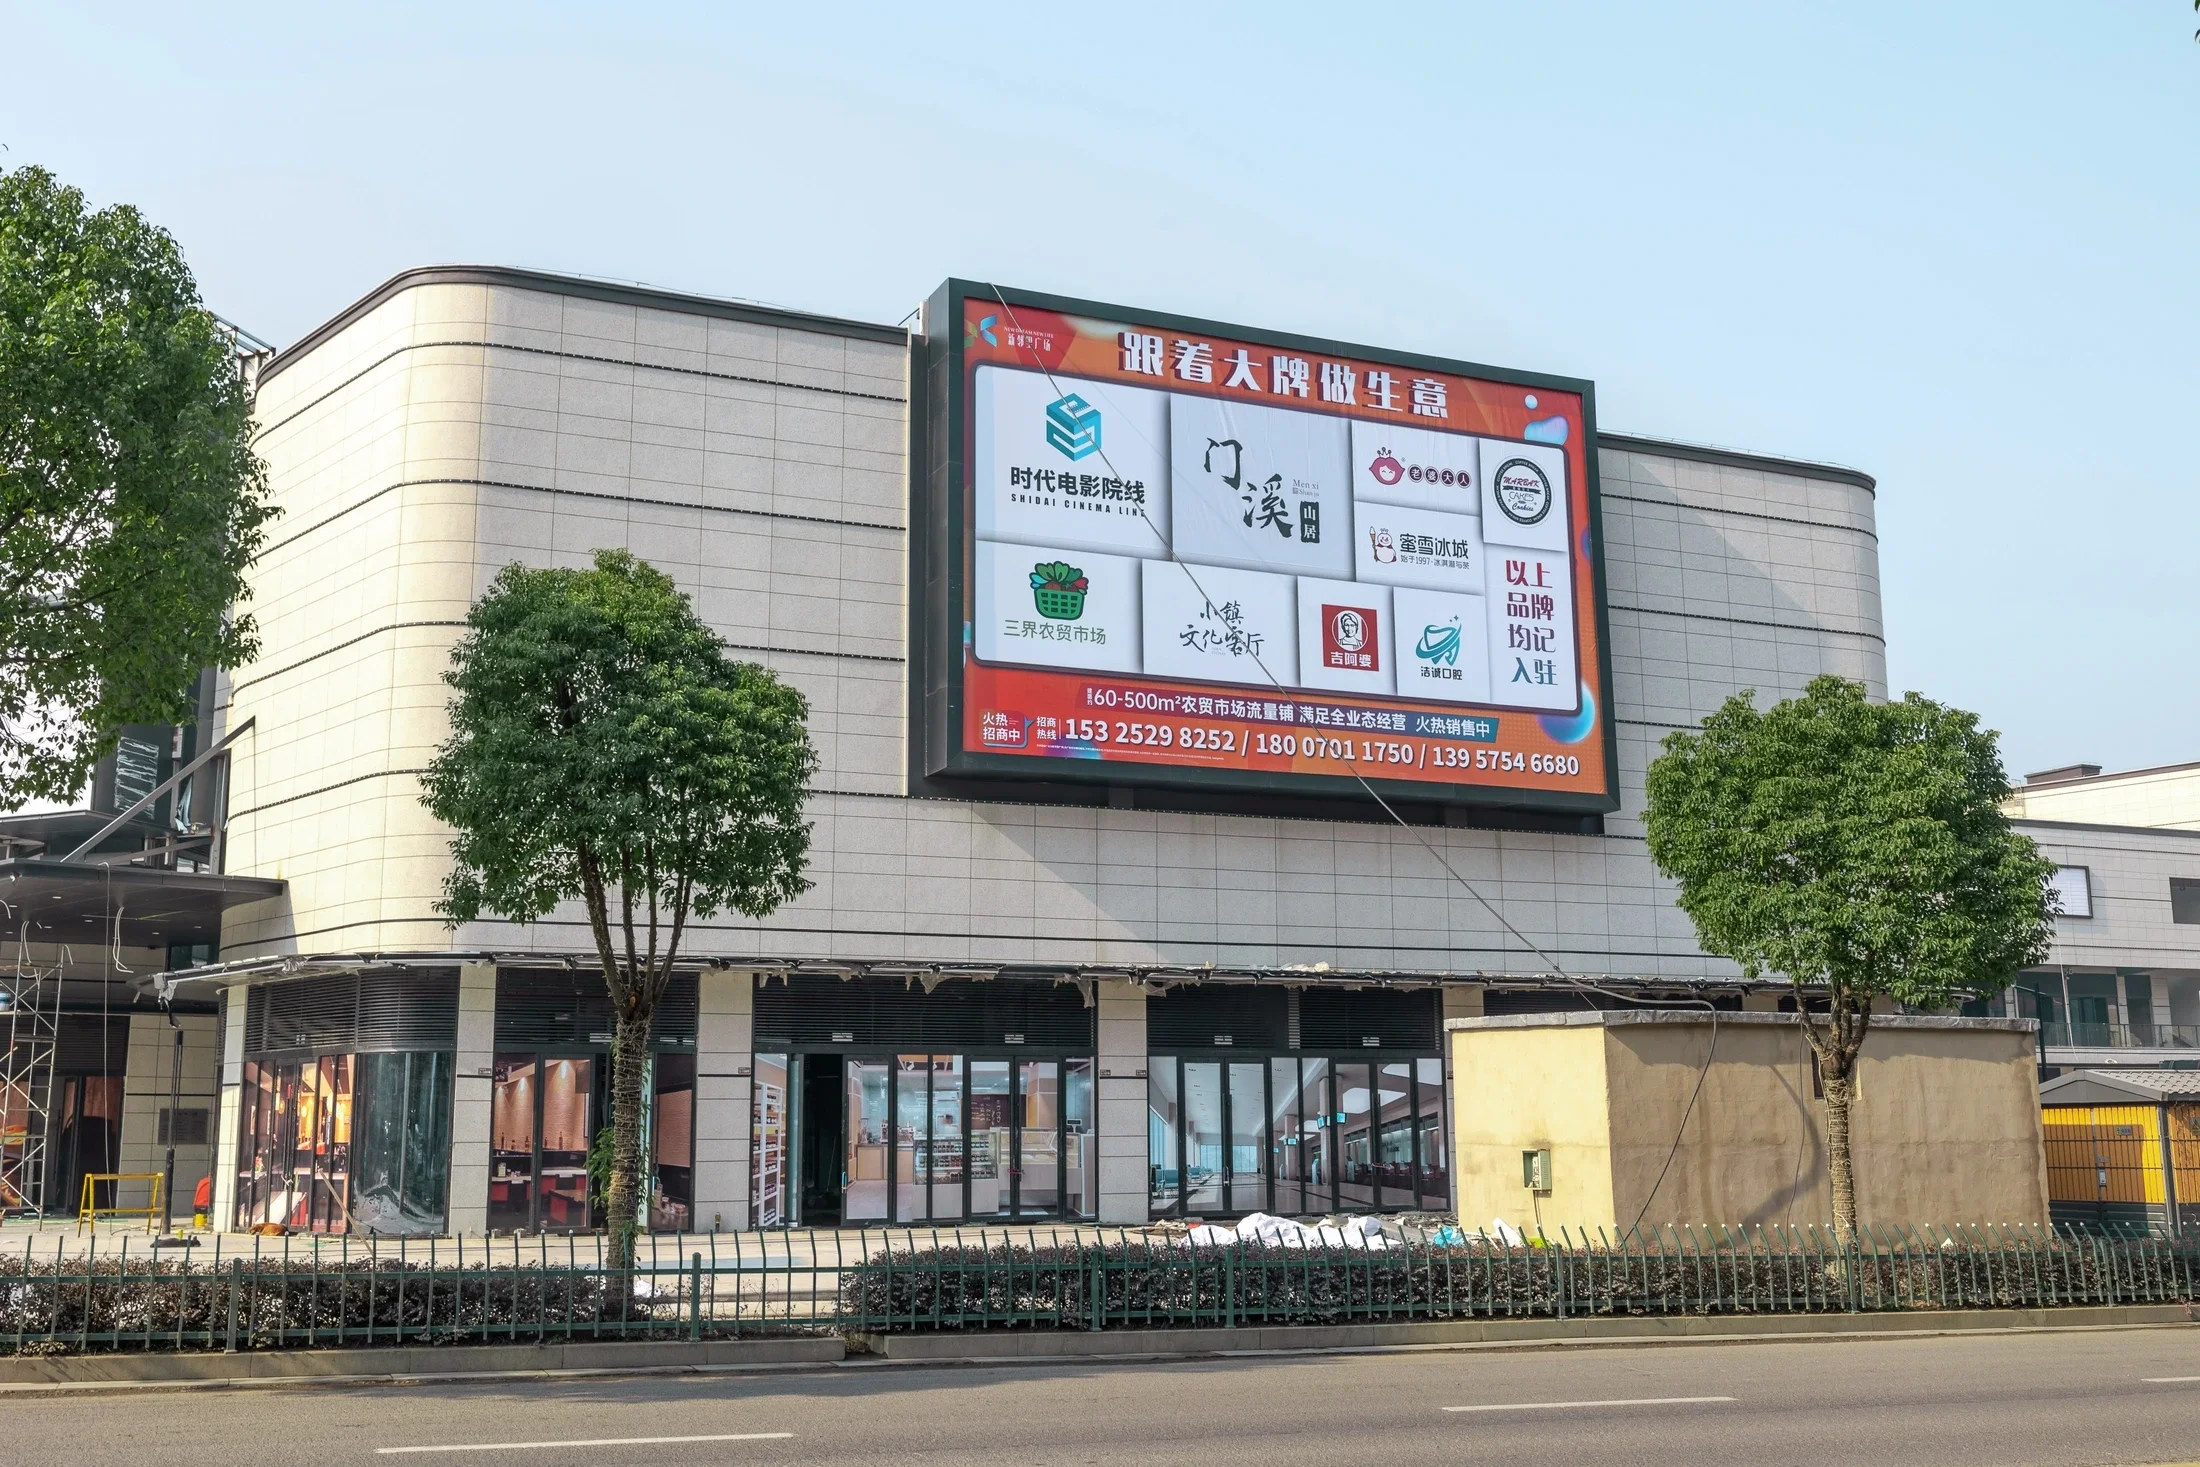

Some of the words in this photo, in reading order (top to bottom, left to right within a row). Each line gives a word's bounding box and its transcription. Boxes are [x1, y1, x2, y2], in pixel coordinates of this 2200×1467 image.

[1122, 331, 1449, 419] 跟着大牌做生意
[1010, 466, 1146, 505] 时代电影院线
[1293, 479, 1310, 489] Men
[1509, 492, 1534, 502] CAKES
[1011, 493, 1056, 507] SHIDAI
[1064, 499, 1111, 513] CINEMA
[1303, 505, 1317, 540] 山居
[1399, 532, 1469, 560] 蜜雪冰城
[1505, 559, 1553, 589] 以上
[1506, 591, 1555, 621] 品牌
[1003, 619, 1107, 646] 三界农贸市场
[1420, 665, 1462, 681] 洁诚口腔
[1510, 656, 1559, 686] 入驻
[982, 711, 1009, 727] 火热
[1036, 716, 1057, 728] 招商
[1299, 705, 1407, 731] 满足全业态经营
[1415, 716, 1491, 739] 火热销售中
[982, 726, 1021, 742] 招商中
[1036, 728, 1057, 741] 热线
[1065, 718, 1109, 743] 153
[1115, 722, 1173, 747] 2529
[1179, 727, 1236, 752] 8252
[1256, 733, 1297, 757] 180
[1302, 736, 1356, 761] 0701
[1362, 741, 1414, 765] 1750
[1433, 746, 1471, 768] 139
[1475, 750, 1526, 773] 5754
[1530, 753, 1580, 776] 6680
